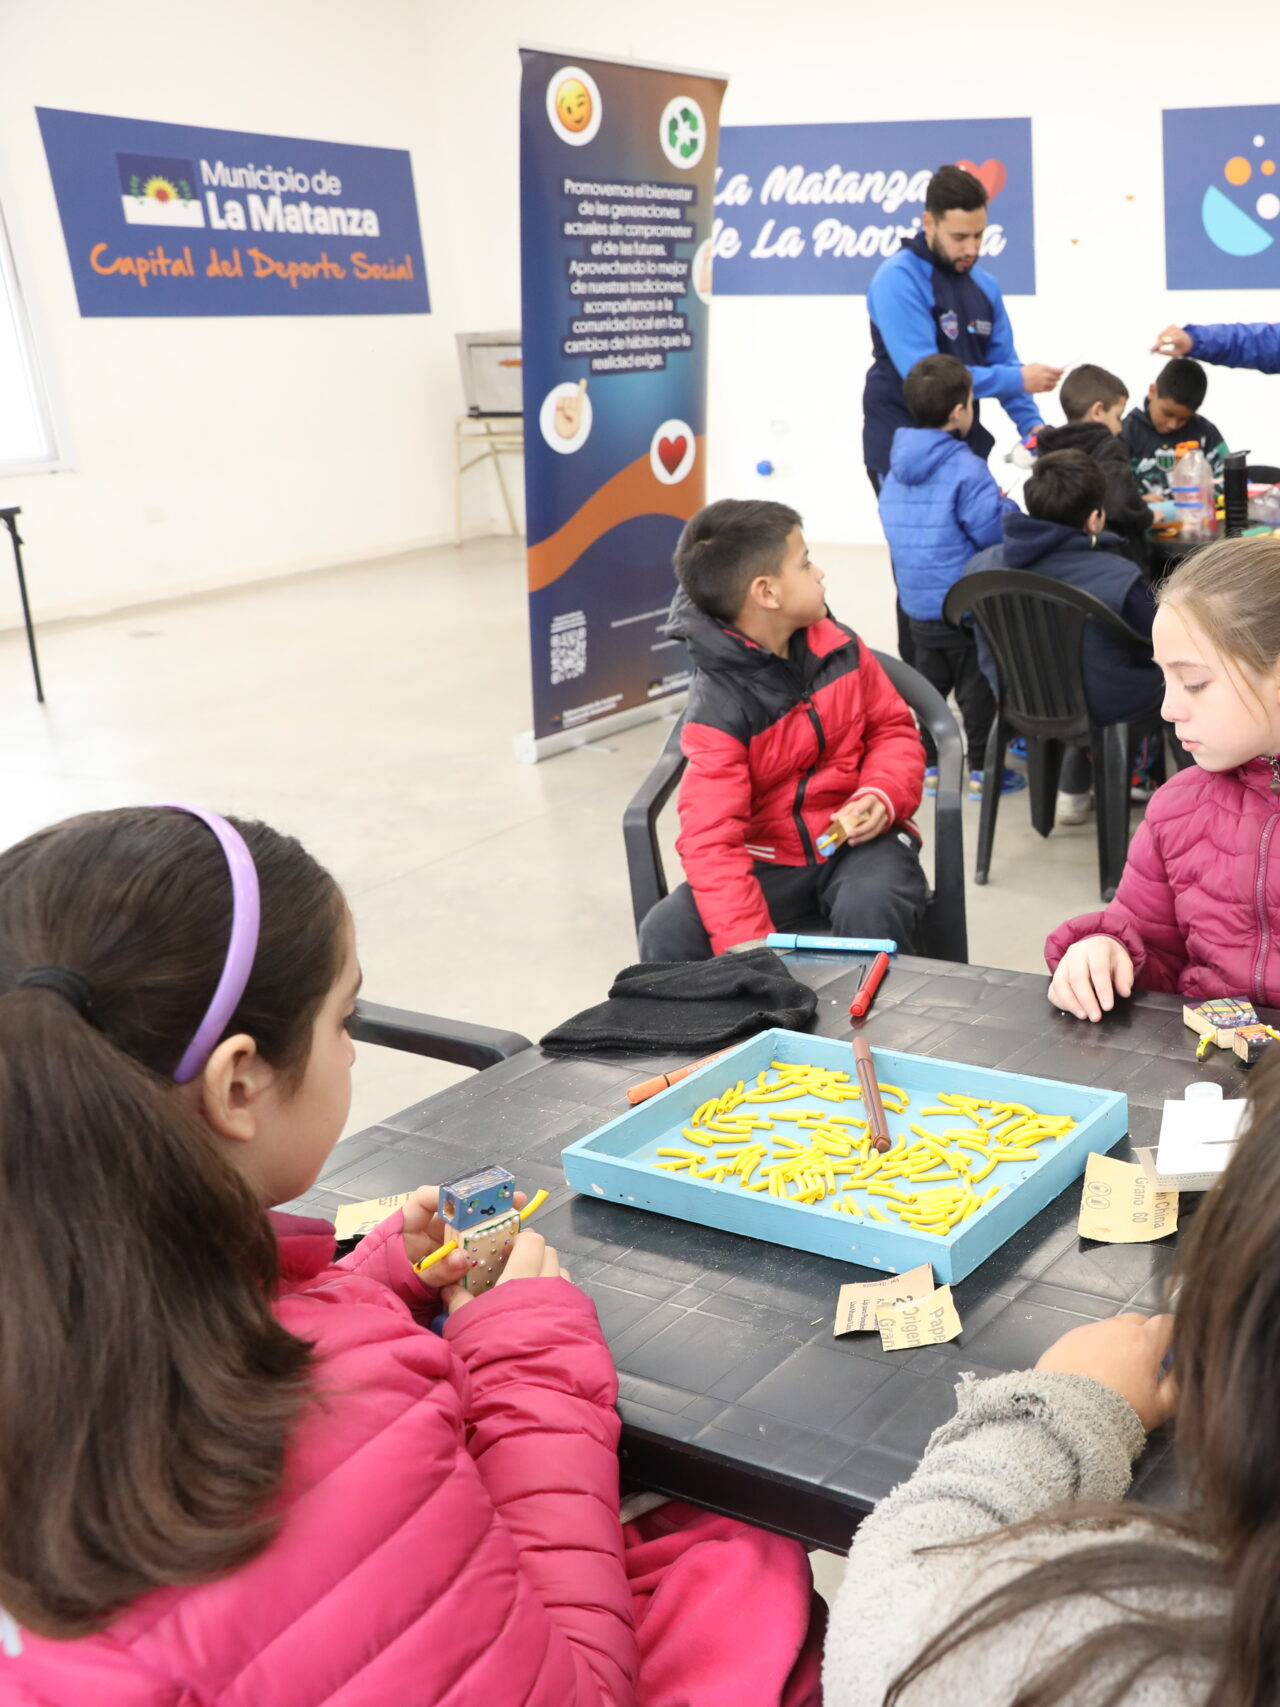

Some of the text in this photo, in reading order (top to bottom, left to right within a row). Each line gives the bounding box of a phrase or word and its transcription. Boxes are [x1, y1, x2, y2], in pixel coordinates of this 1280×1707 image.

[201, 160, 342, 198] Municipio de
[564, 178, 634, 198] Promovemos
[760, 164, 933, 213] Matanza
[206, 192, 380, 237] La Matanza
[578, 200, 595, 216] de
[750, 219, 805, 259] La
[90, 242, 414, 288] Capital del Deporte Social
[1132, 1177, 1149, 1223] Grano 60
[1154, 1201, 1171, 1229] China
